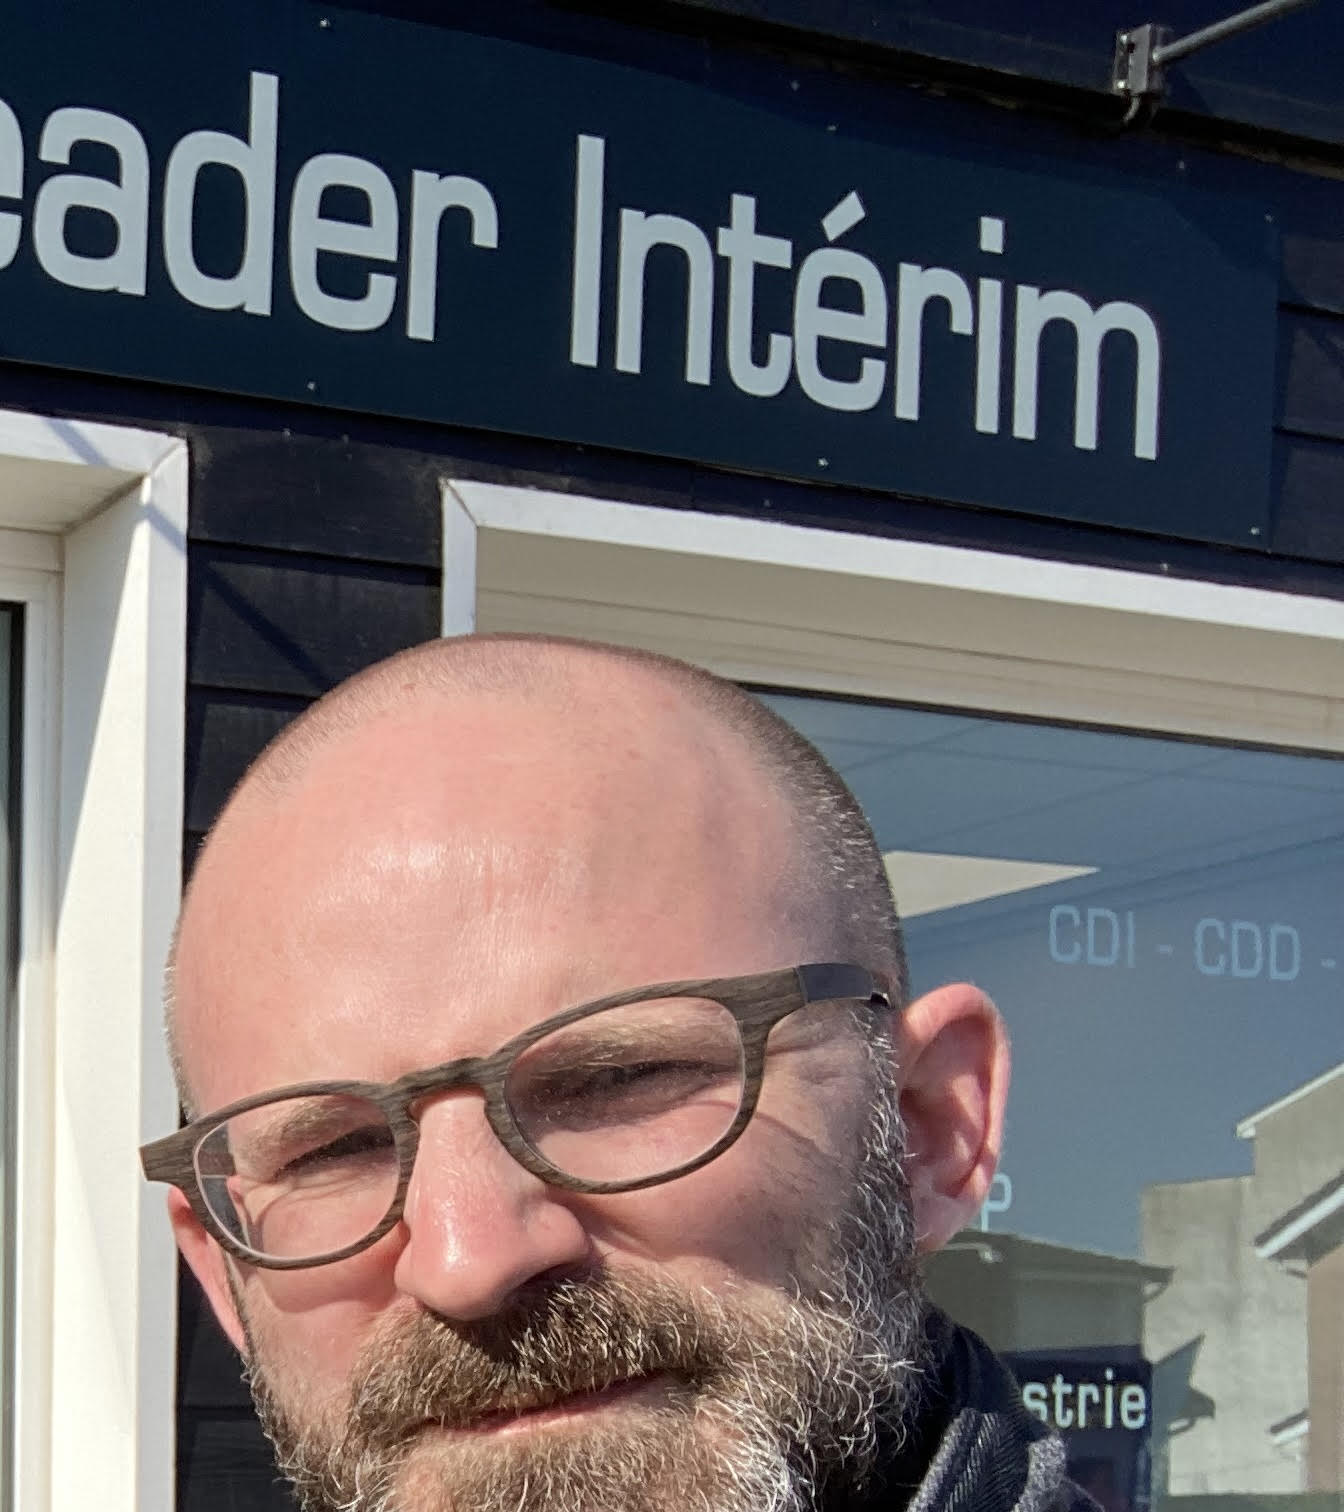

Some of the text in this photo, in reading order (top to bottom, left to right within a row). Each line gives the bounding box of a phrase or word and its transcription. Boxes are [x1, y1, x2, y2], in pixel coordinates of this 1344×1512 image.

[569, 134, 1161, 461] Intérim
[1049, 904, 1136, 969] CDI
[1194, 917, 1302, 981] CDD
[1022, 1368, 1146, 1430] strie
